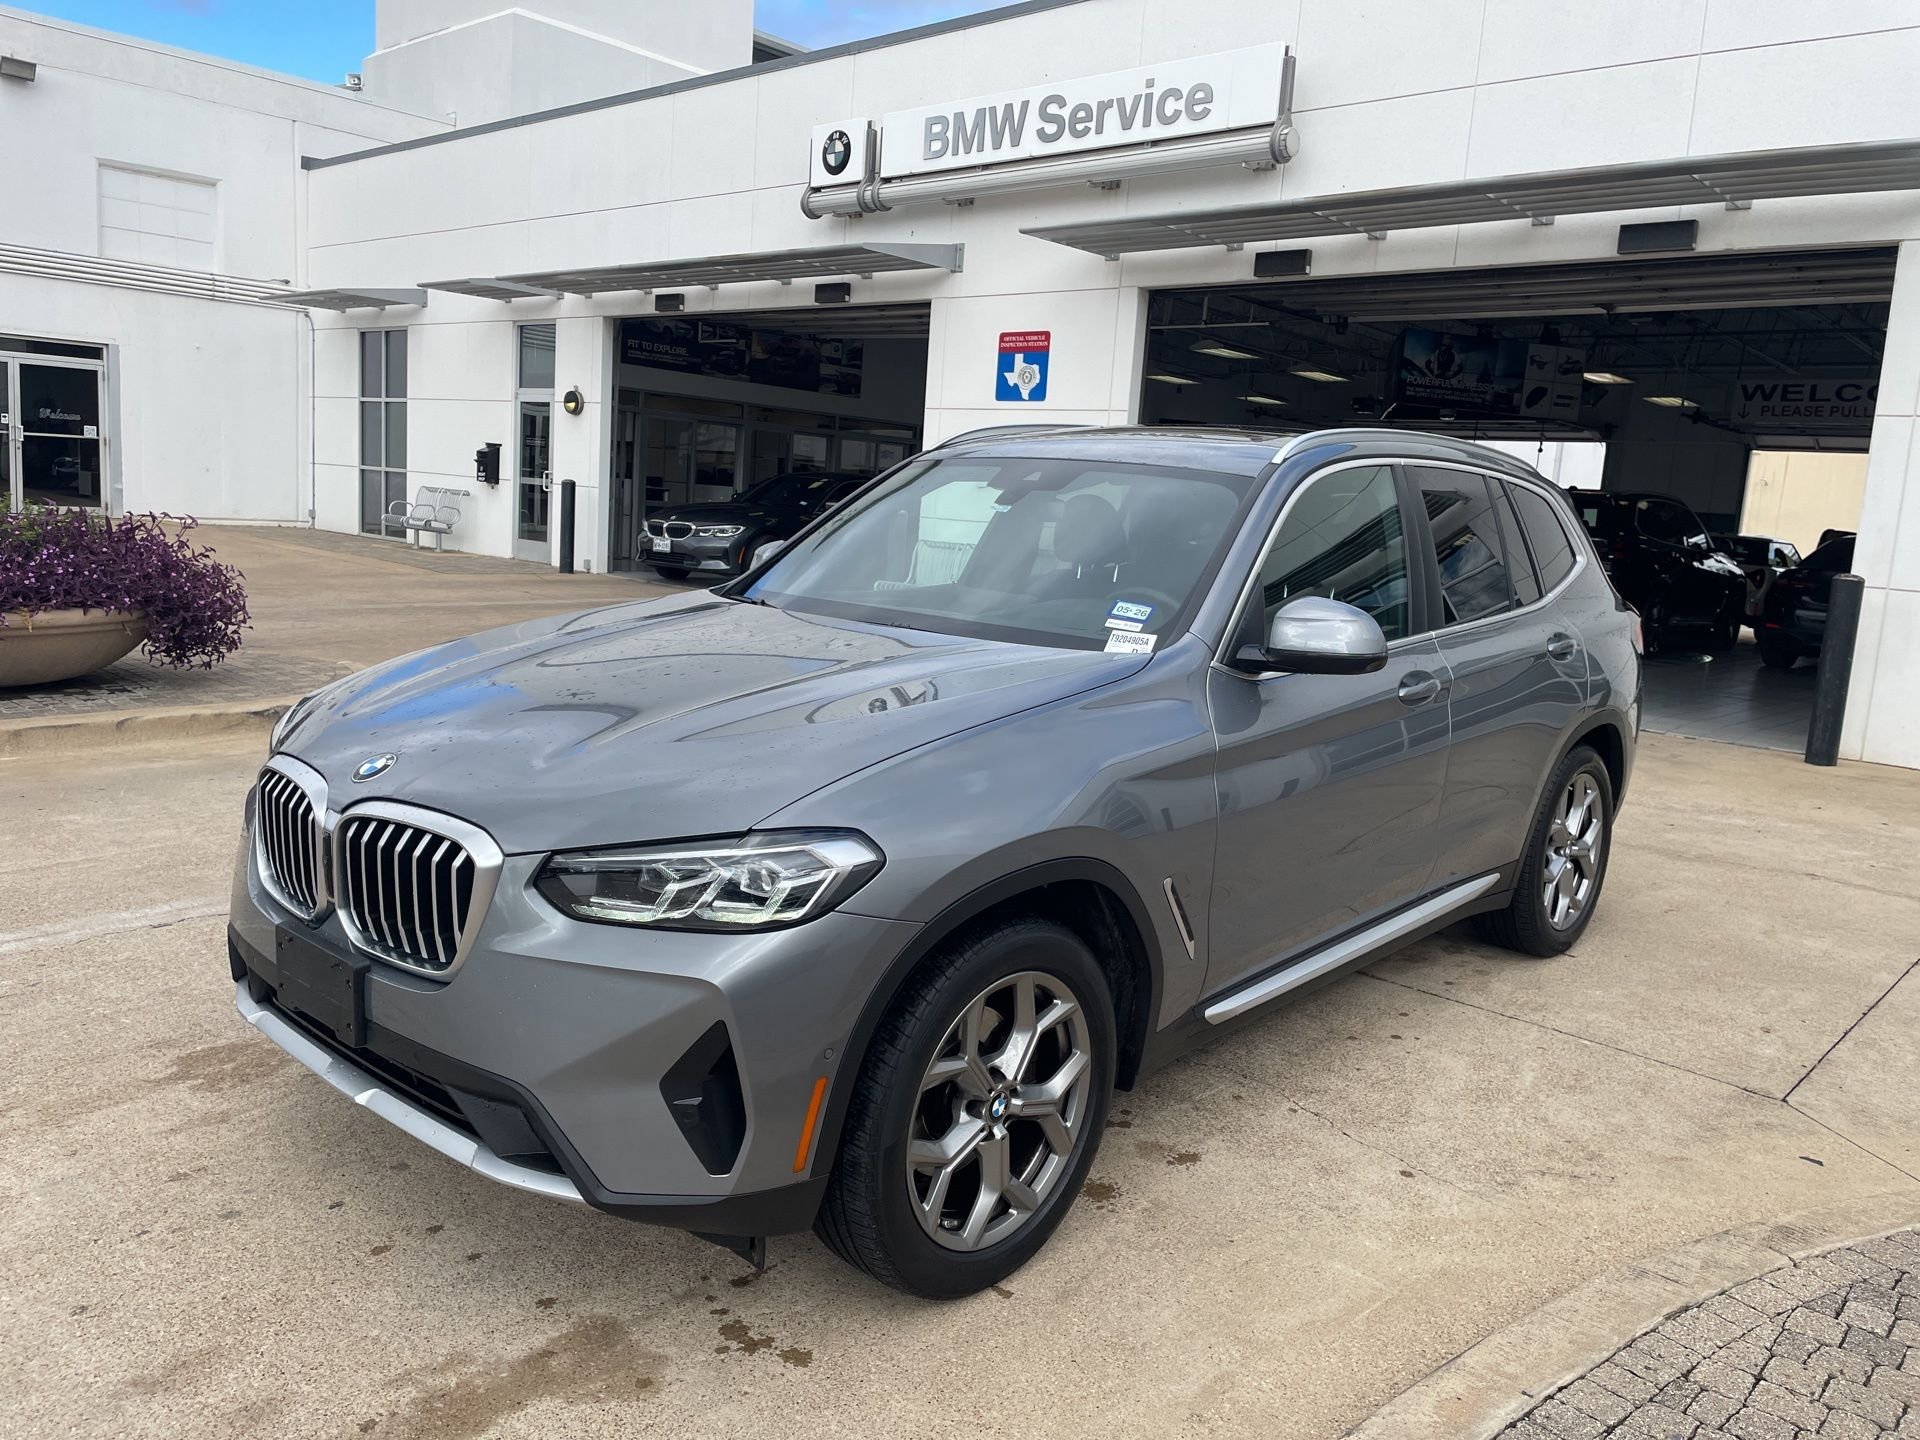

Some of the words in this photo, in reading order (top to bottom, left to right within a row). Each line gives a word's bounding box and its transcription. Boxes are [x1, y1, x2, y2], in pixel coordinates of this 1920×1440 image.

[923, 100, 1030, 160] BMW
[1036, 78, 1214, 143] Service
[627, 338, 639, 348] FIT
[642, 341, 652, 350] TO
[1406, 375, 1452, 388] POWERFUL
[39, 407, 82, 421] Welcome
[1760, 405, 1825, 417] PLEASE
[1830, 406, 1874, 417] PULL
